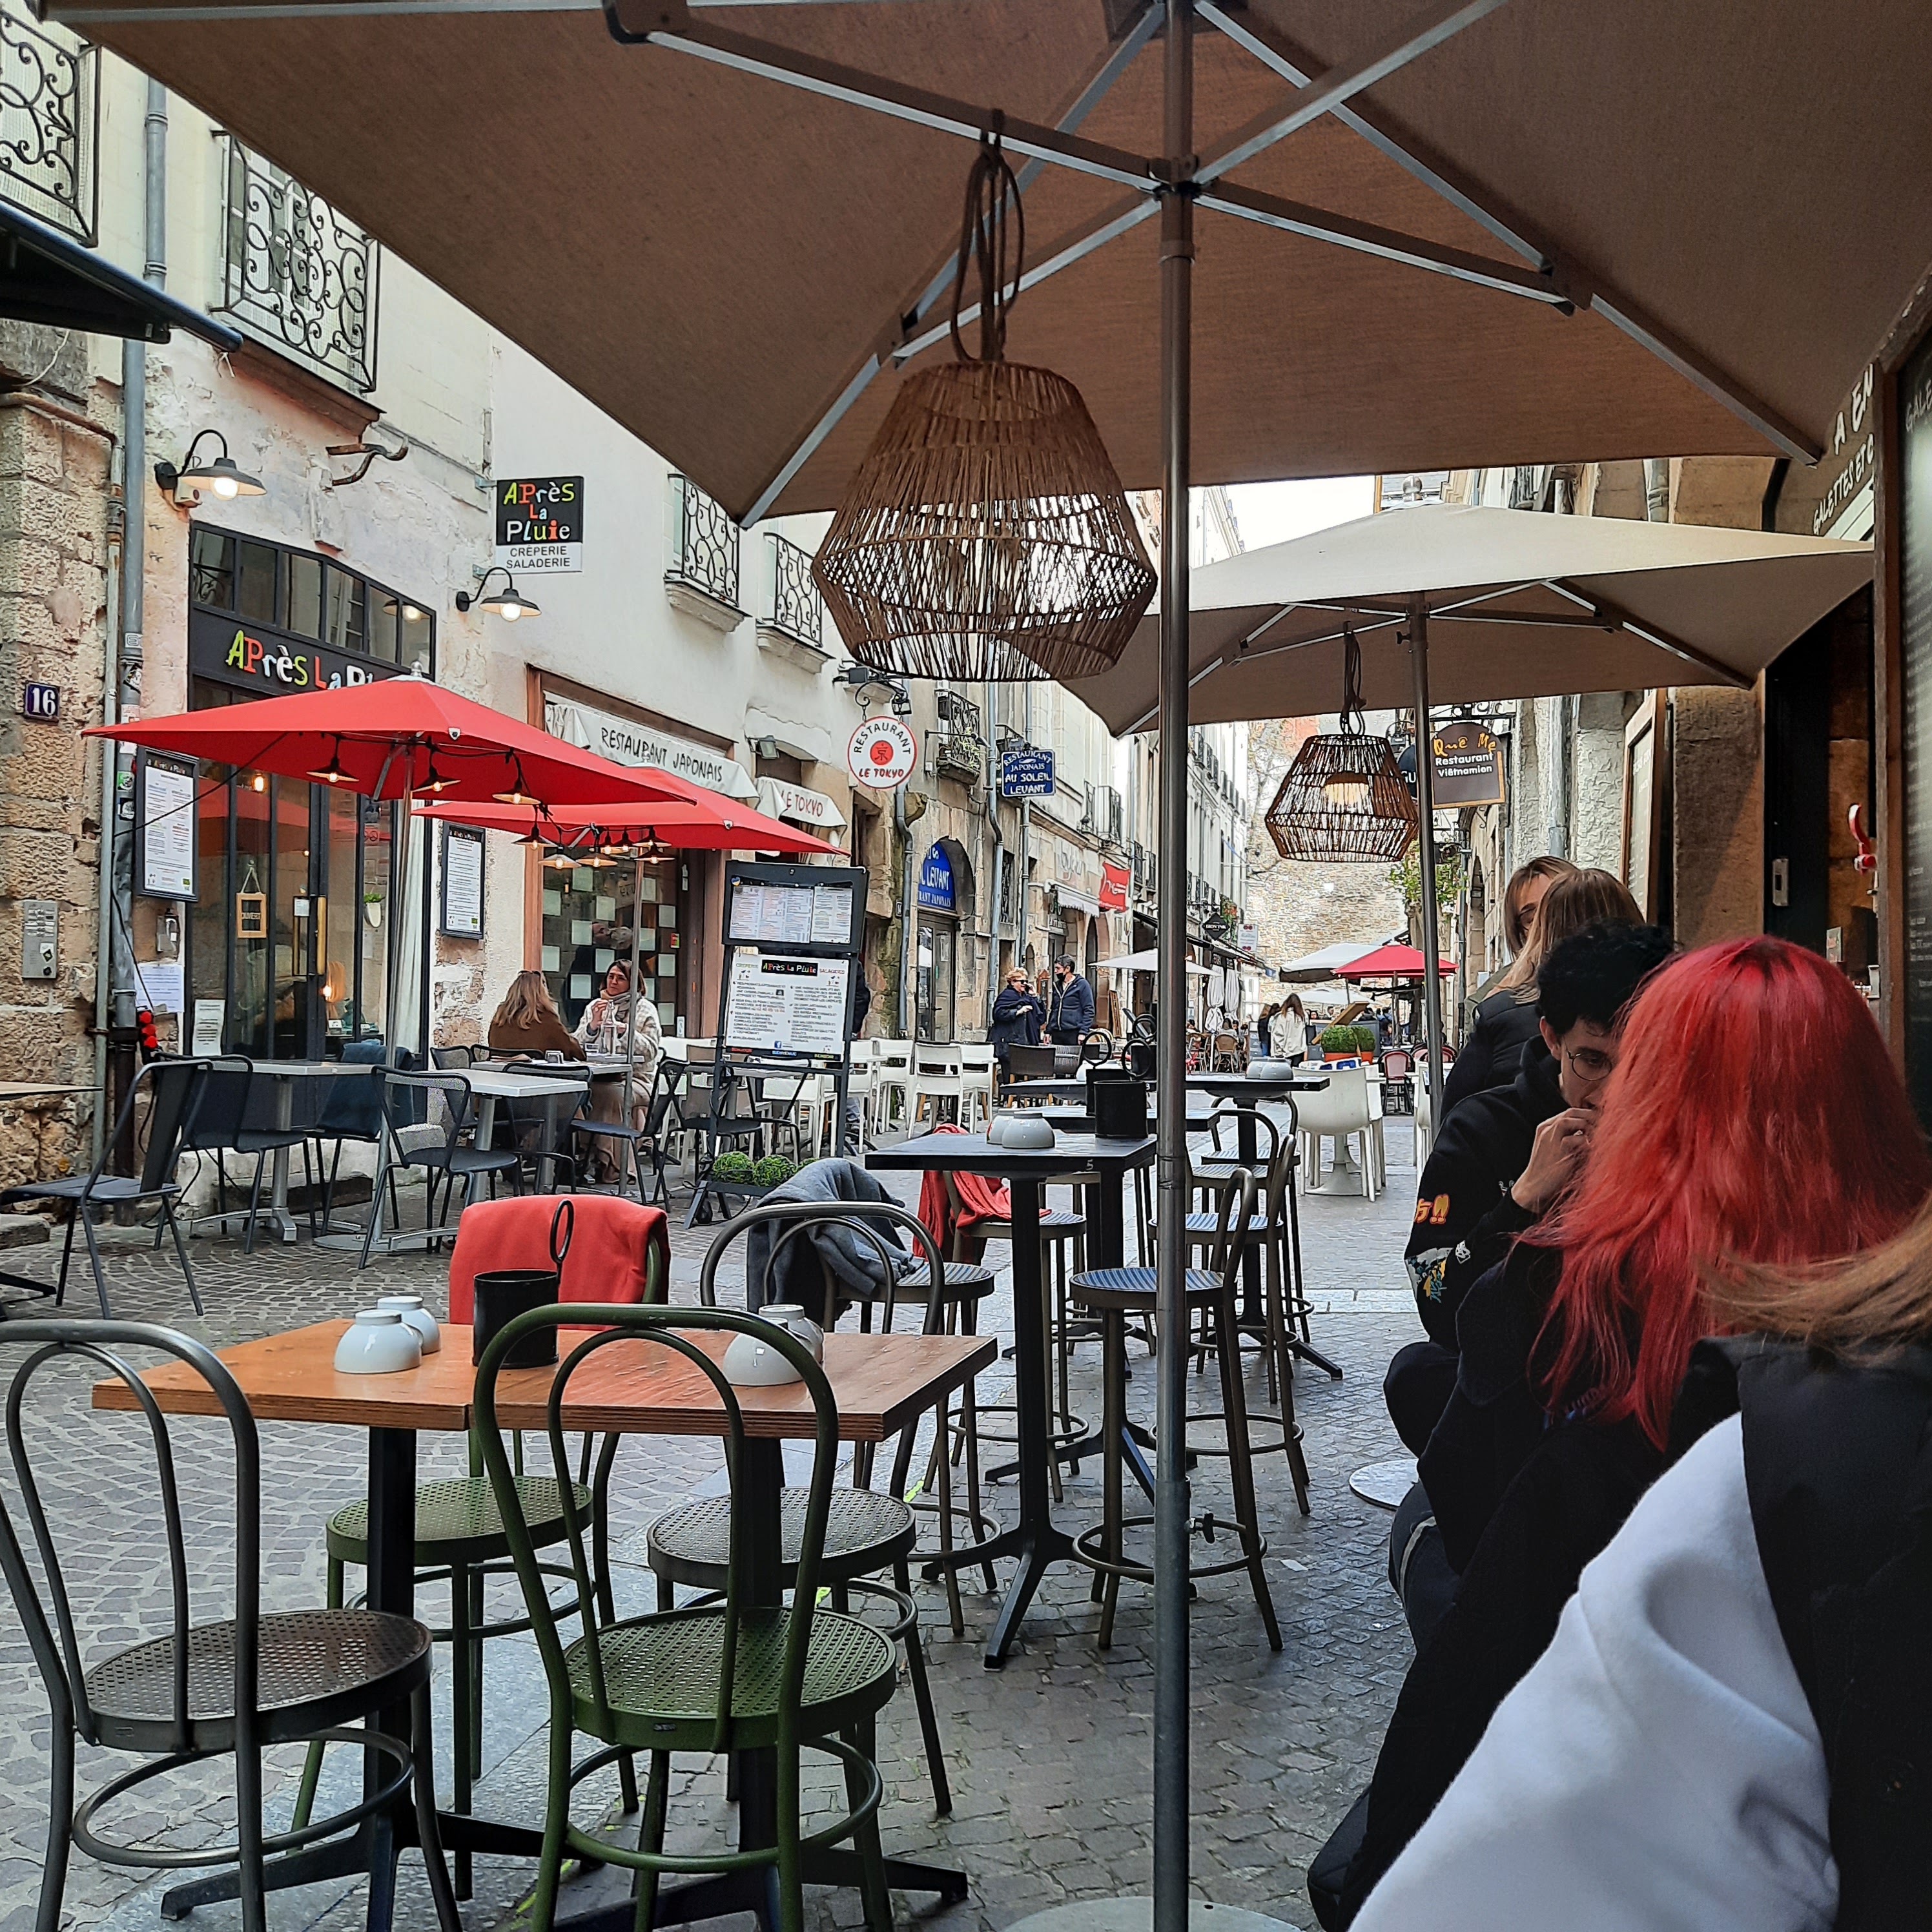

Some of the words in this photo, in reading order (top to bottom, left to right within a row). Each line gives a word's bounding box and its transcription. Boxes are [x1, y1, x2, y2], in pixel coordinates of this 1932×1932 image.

[1813, 459, 1854, 535] GALETTES
[1856, 443, 1866, 482] ET
[529, 504, 547, 519] La
[507, 520, 570, 542] Pluie
[510, 545, 567, 557] CRÊPERIE
[506, 557, 570, 568] SALADERIE
[32, 687, 56, 715] 16
[854, 722, 910, 754] RESTAURANT
[601, 727, 668, 767] RESTAURANT
[673, 752, 723, 782] JAPONAIS
[1003, 750, 1052, 766] RESTAURANT
[1435, 752, 1494, 766] Restaurant
[859, 768, 870, 777] LE
[874, 768, 904, 778] TOKYO
[1011, 763, 1045, 772] JAPONAIS
[1005, 774, 1017, 783] AU
[1020, 772, 1052, 782] SOLEIL
[1010, 783, 1046, 794] LEVANT
[795, 794, 823, 817] TOKYO
[927, 866, 950, 890] LEVANT
[932, 894, 951, 907] JAPONAIS
[796, 965, 816, 974] Pluie
[1086, 1158, 1094, 1170] 5
